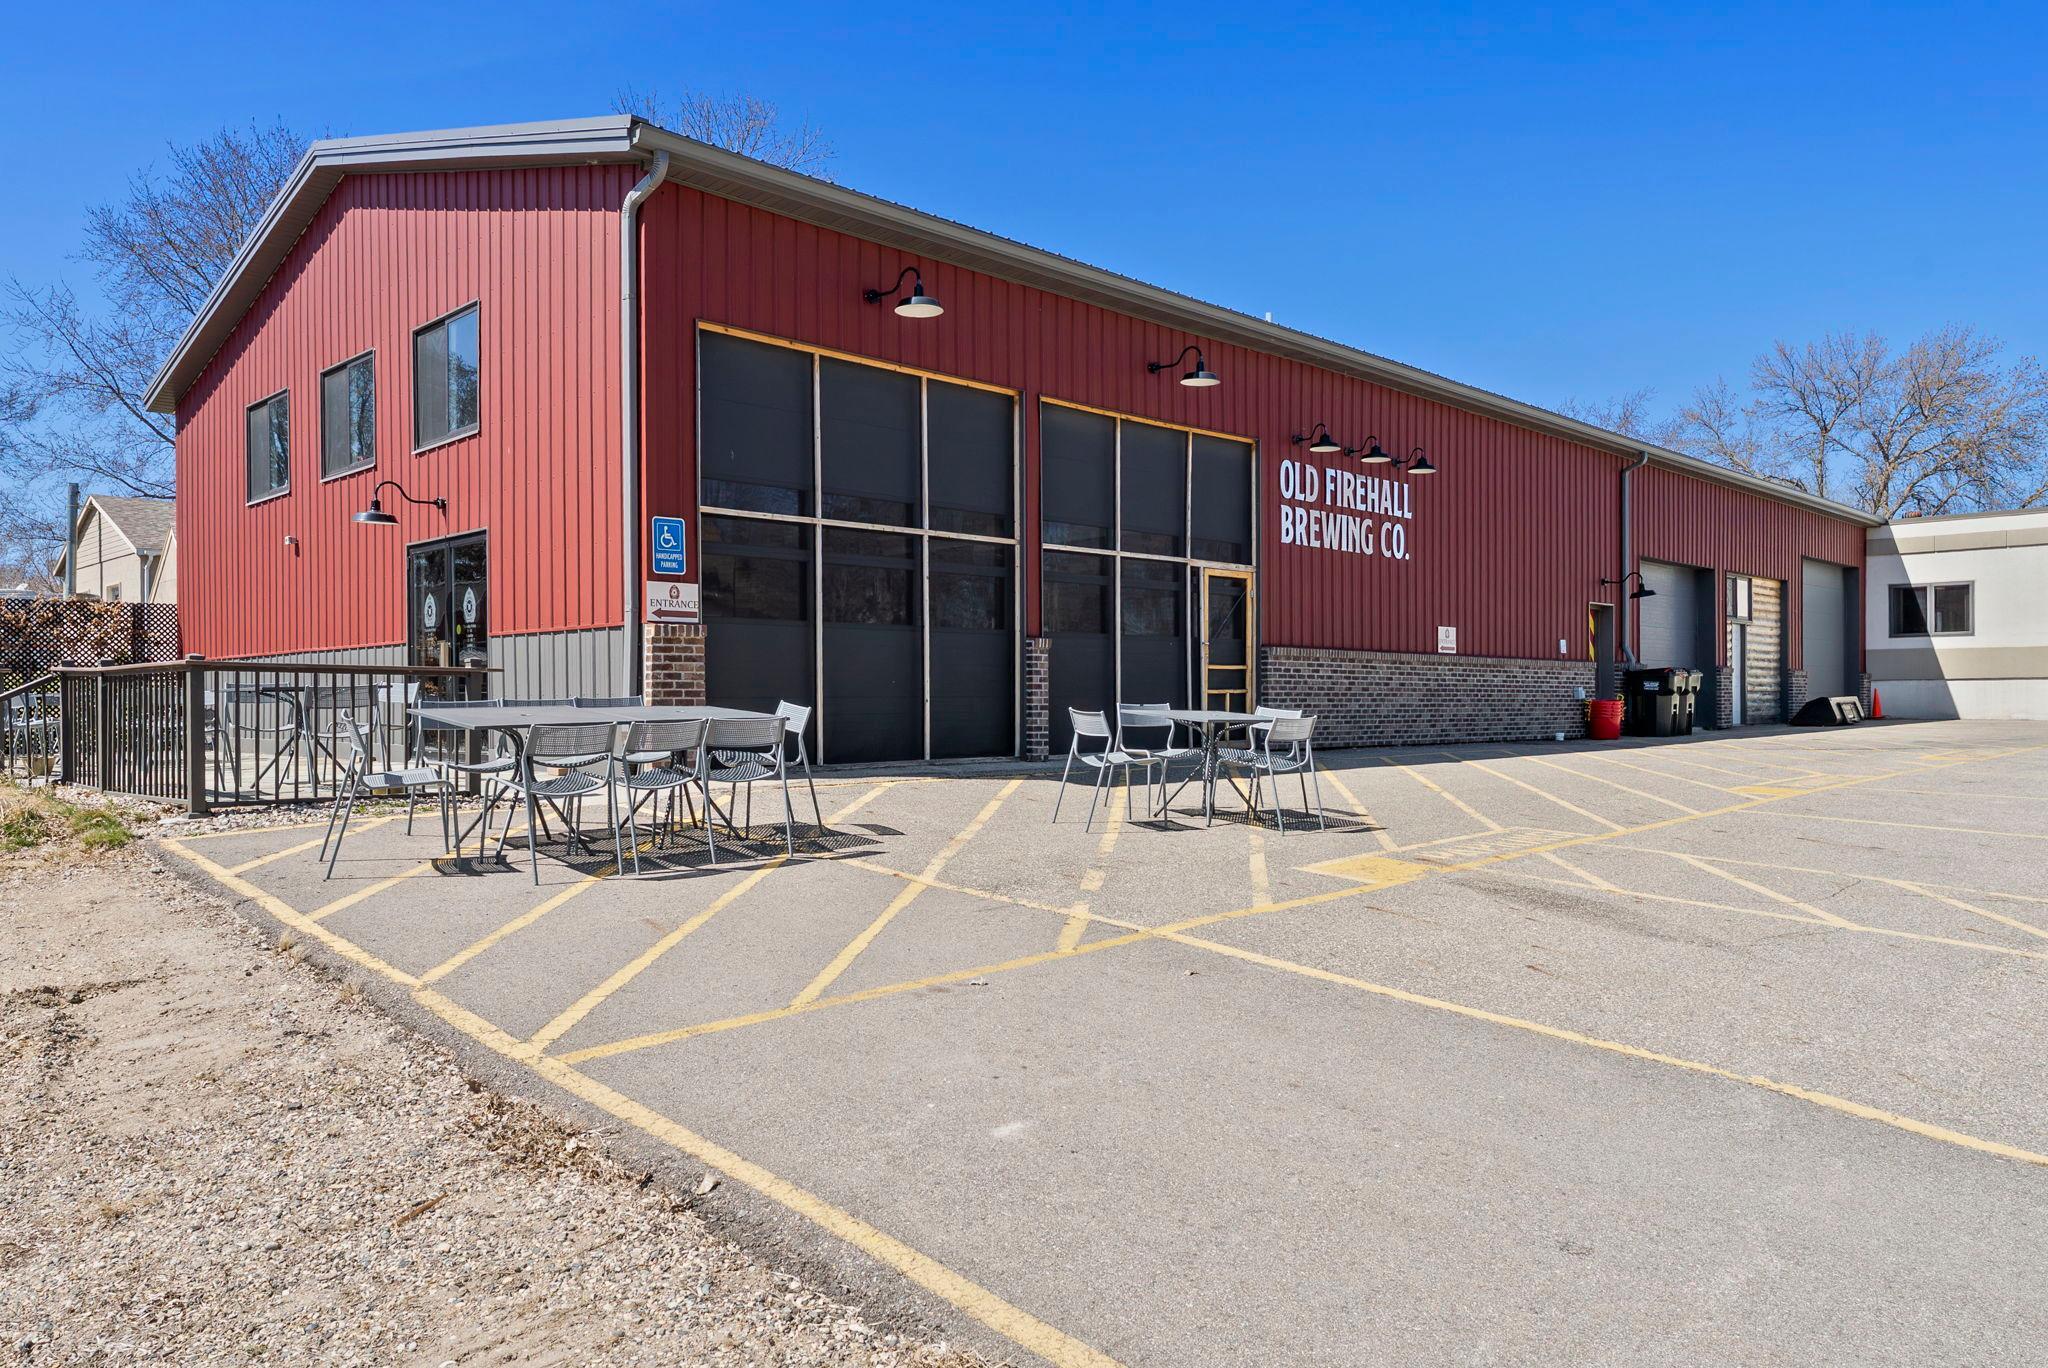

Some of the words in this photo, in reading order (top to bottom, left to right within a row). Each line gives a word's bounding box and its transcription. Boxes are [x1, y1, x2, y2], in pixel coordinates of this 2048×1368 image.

[1280, 459, 1319, 502] OLD
[1325, 467, 1412, 519] FIREHALL
[1280, 504, 1374, 556] BREWING
[1380, 521, 1410, 561] CO.
[656, 552, 682, 560] HANDICAPPED
[650, 598, 699, 608] ENTRANCE
